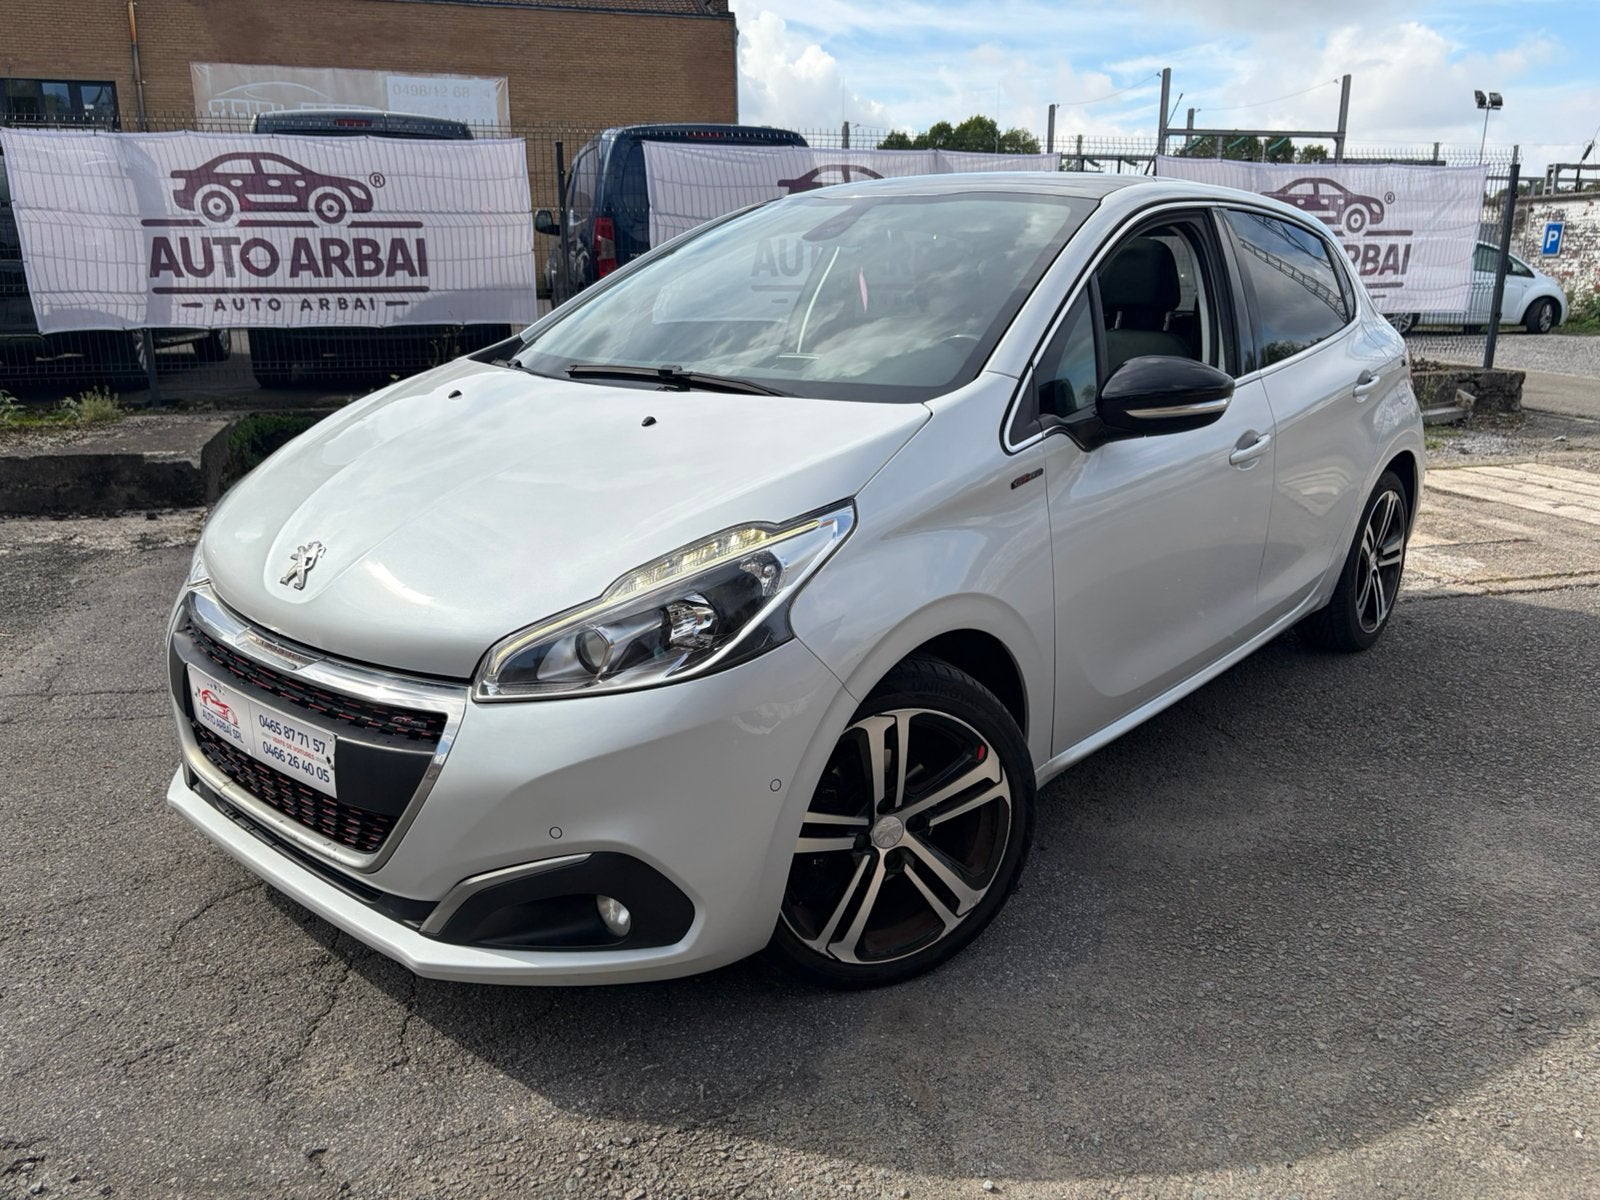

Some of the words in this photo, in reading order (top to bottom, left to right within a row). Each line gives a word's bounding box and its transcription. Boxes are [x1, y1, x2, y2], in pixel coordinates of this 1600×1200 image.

[150, 236, 280, 278] AUTO
[289, 237, 428, 278] ARBAI
[1546, 230, 1559, 249] P
[1343, 243, 1412, 276] RBAI
[213, 298, 282, 312] AUTO
[299, 297, 375, 312] ARBAI
[259, 714, 282, 736] 0465
[283, 725, 295, 742] 87
[297, 732, 310, 748] 71
[312, 738, 326, 755] 57
[262, 741, 286, 763] 0466
[287, 753, 300, 769] 26
[302, 760, 315, 776] 40
[316, 766, 330, 784] 05
